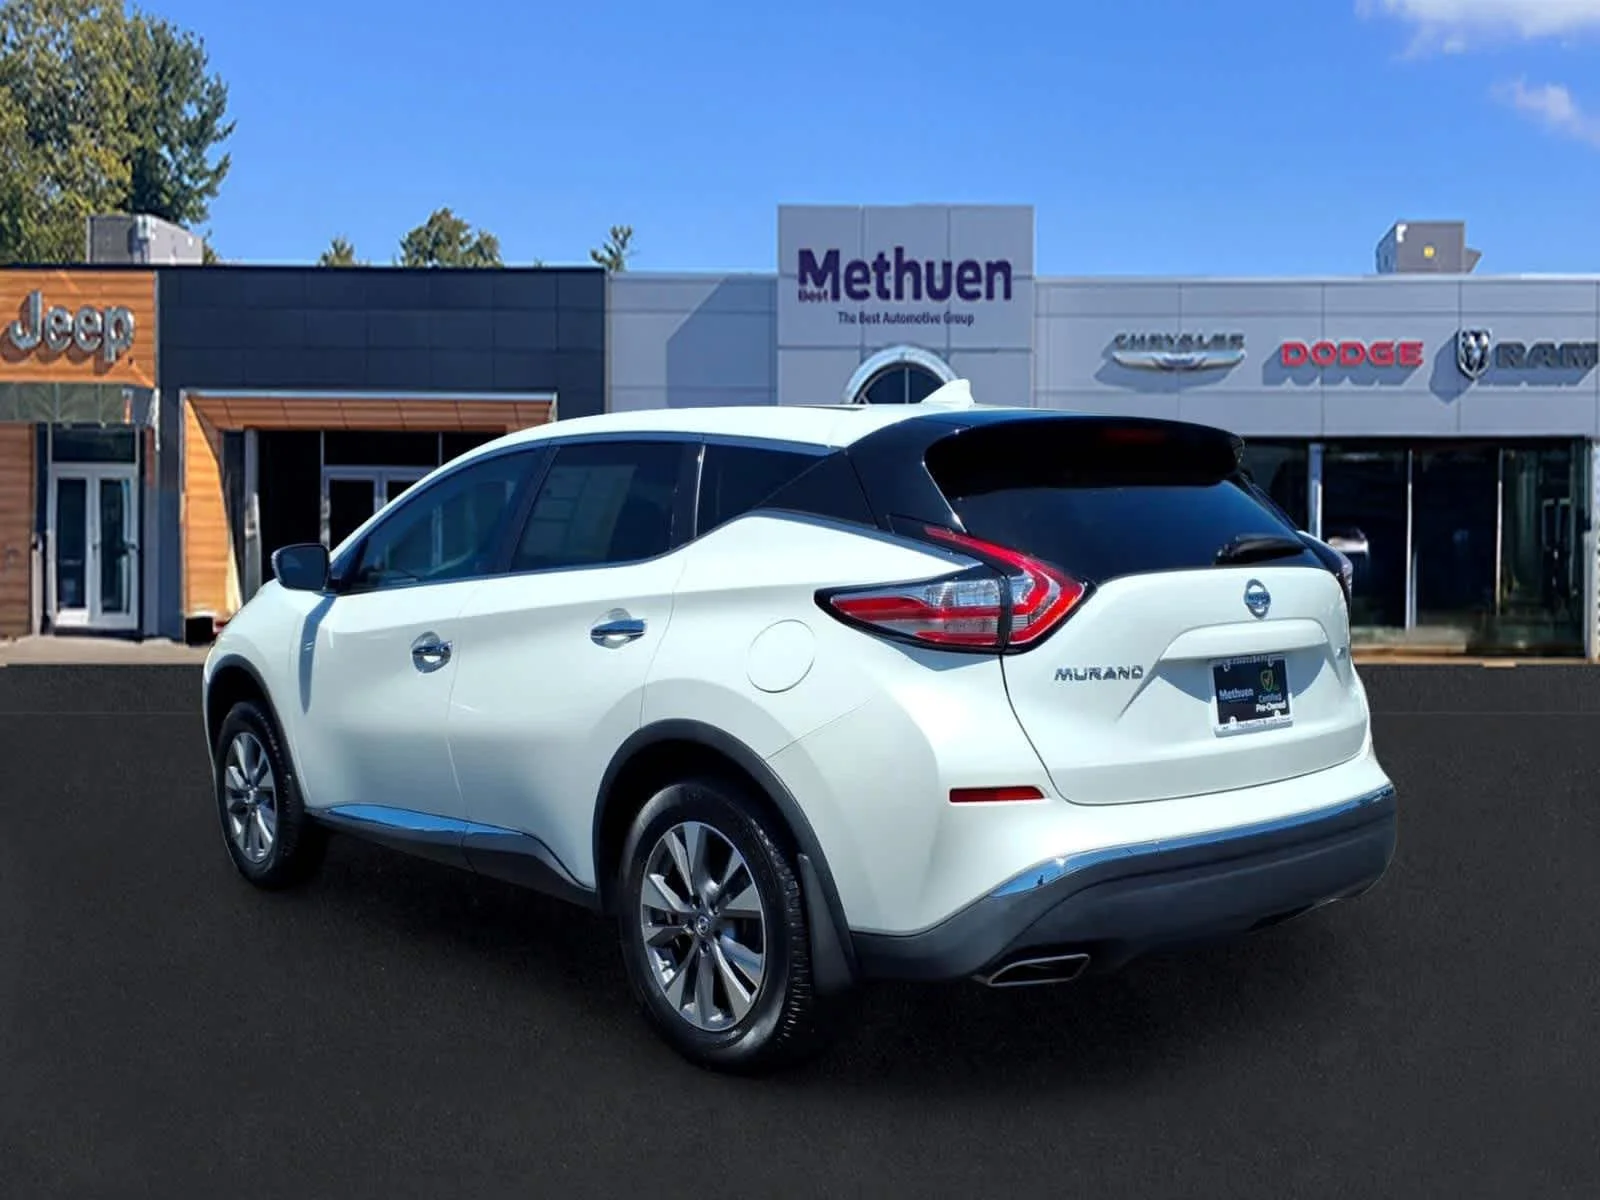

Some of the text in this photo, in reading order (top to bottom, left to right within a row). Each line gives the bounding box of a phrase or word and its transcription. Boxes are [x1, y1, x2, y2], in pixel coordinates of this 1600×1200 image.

[798, 246, 1012, 302] Methuen
[798, 289, 829, 303] Best
[9, 290, 136, 363] Jeep
[838, 311, 975, 327] The Best Automotive Group
[1281, 340, 1424, 367] DODGE
[1495, 341, 1599, 369] RAM
[1054, 665, 1144, 681] MURANO
[1218, 687, 1254, 701] Methuen
